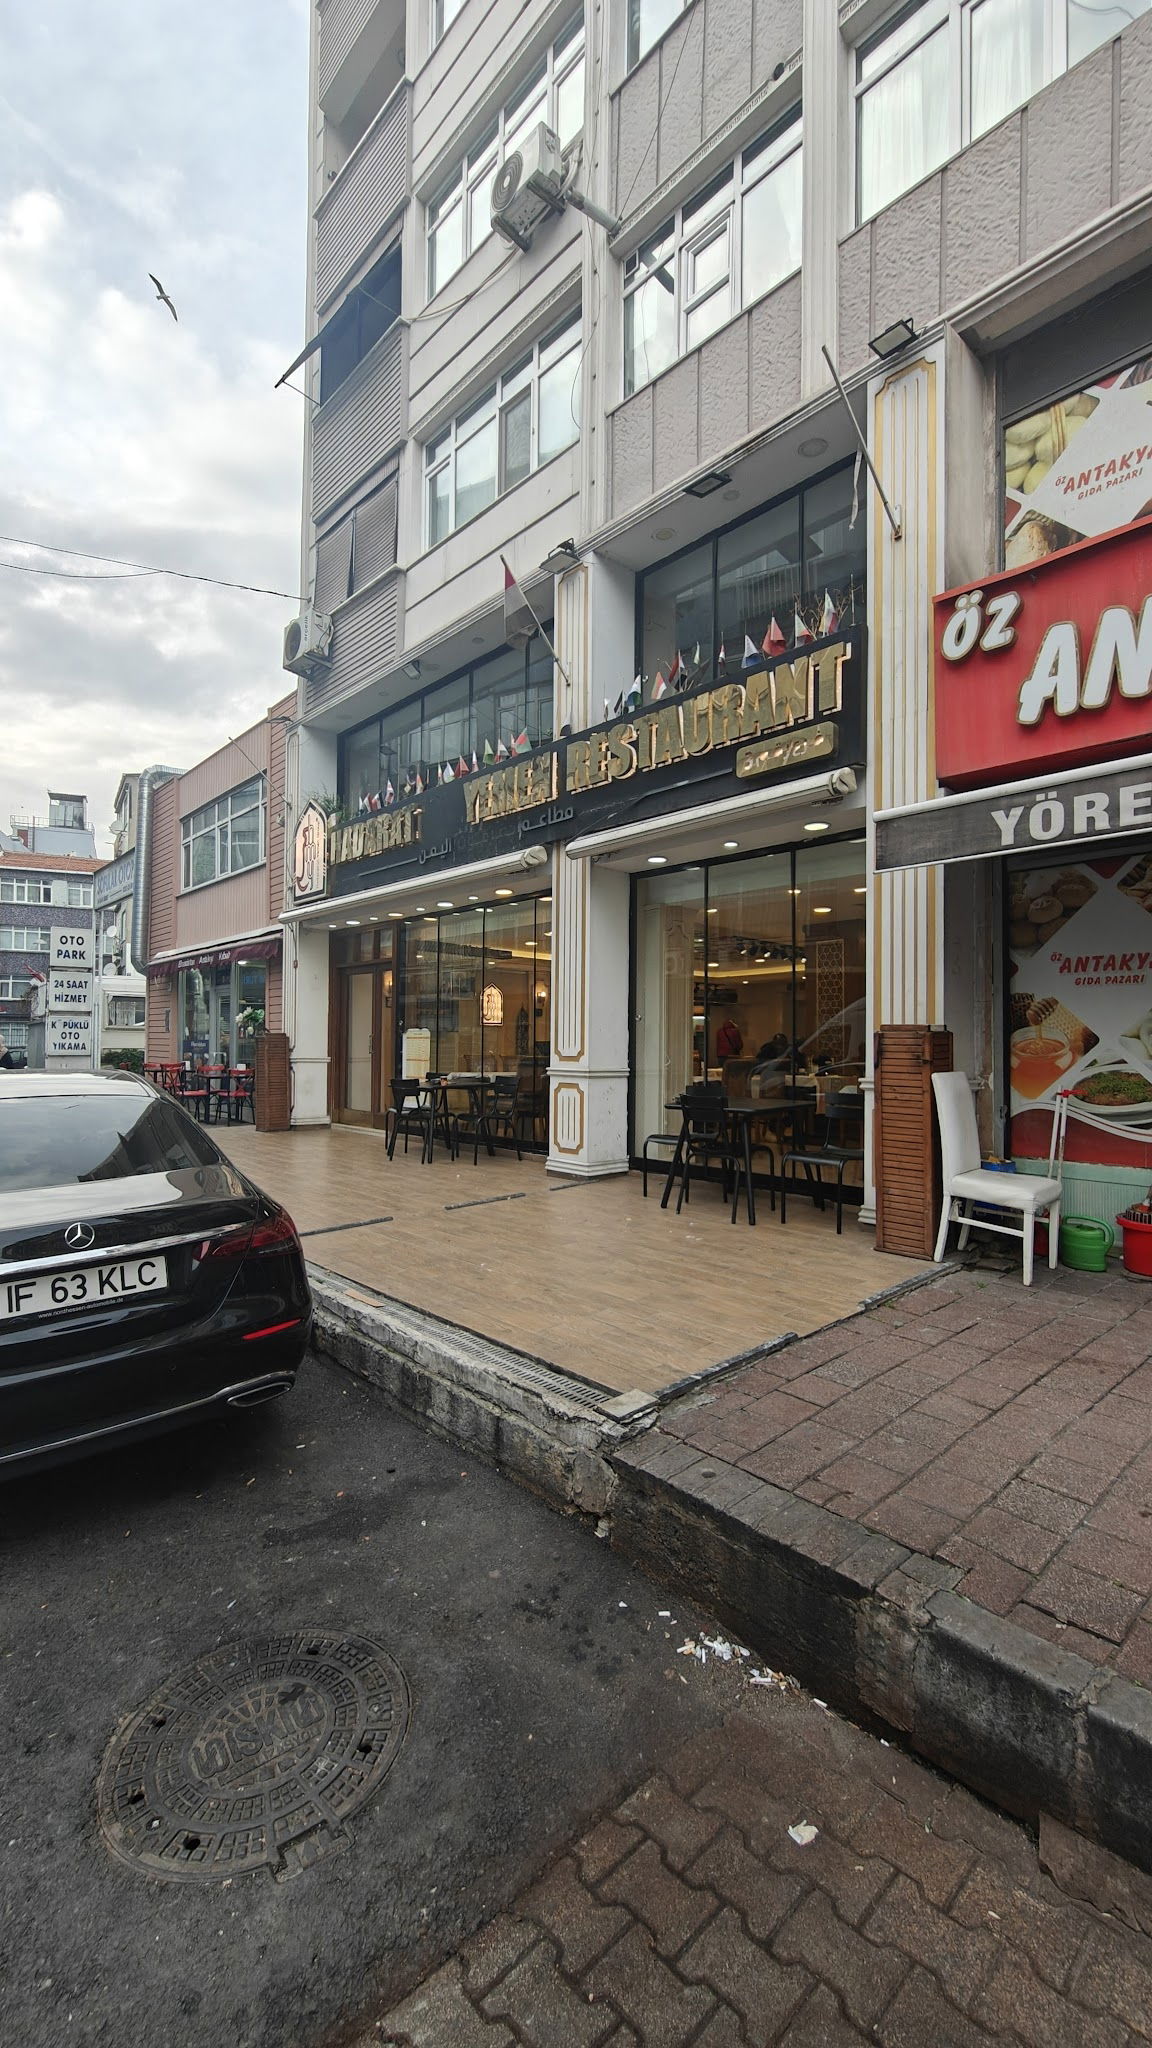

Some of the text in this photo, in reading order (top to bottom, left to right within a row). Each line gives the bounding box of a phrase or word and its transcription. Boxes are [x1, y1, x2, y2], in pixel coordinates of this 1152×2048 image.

[1055, 474, 1067, 487] ÖZ
[1077, 467, 1143, 500] GIDA PAZARI
[940, 590, 1022, 663] ÖZ
[463, 751, 559, 827] YEMEN
[565, 641, 852, 794] RESTAURANT
[991, 783, 1152, 846] YÖRE
[60, 935, 85, 946] OTO
[57, 950, 86, 960] PARK
[1050, 951, 1152, 974] ÖZ ANTAKY
[54, 980, 88, 989] 24 SAAT
[1074, 974, 1146, 986] GIDA PAZARI
[54, 992, 87, 1003] HİZMET
[61, 1032, 80, 1040] OTO
[53, 1043, 87, 1051] YIKAMA
[7, 1261, 157, 1313] IF 63 KLC
